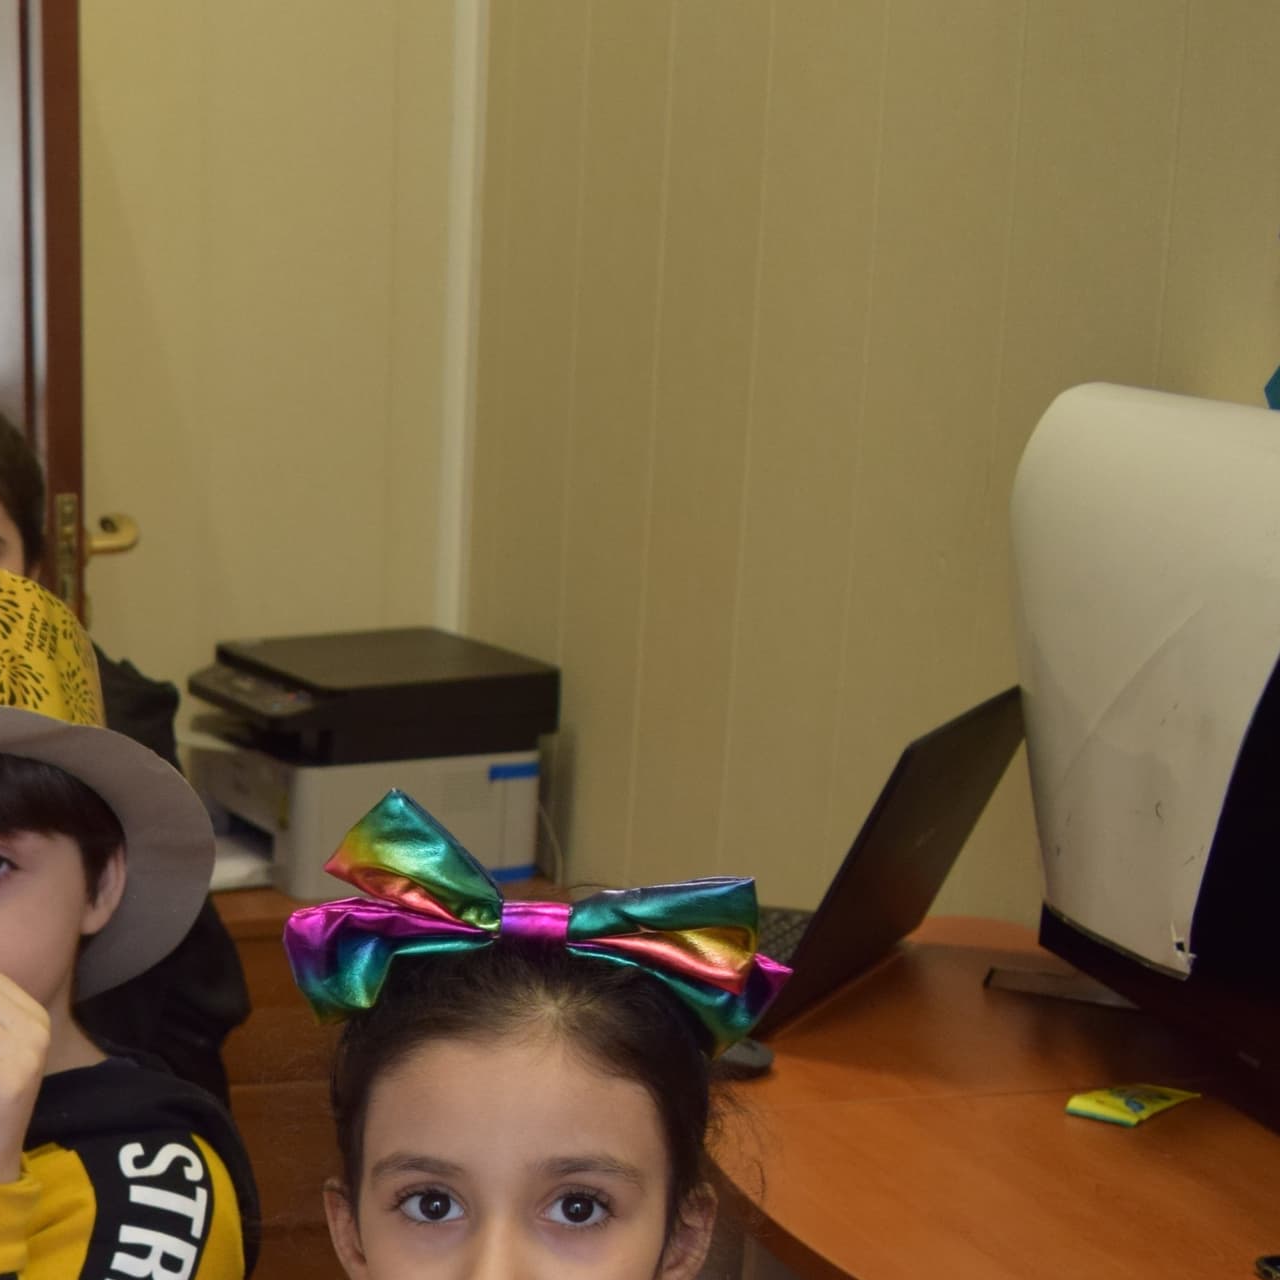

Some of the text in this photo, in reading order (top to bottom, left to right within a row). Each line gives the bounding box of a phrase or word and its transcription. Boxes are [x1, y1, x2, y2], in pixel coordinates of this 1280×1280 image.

[23, 602, 41, 652] HAPPY
[37, 616, 50, 652] NEW
[47, 624, 60, 661] YEAR
